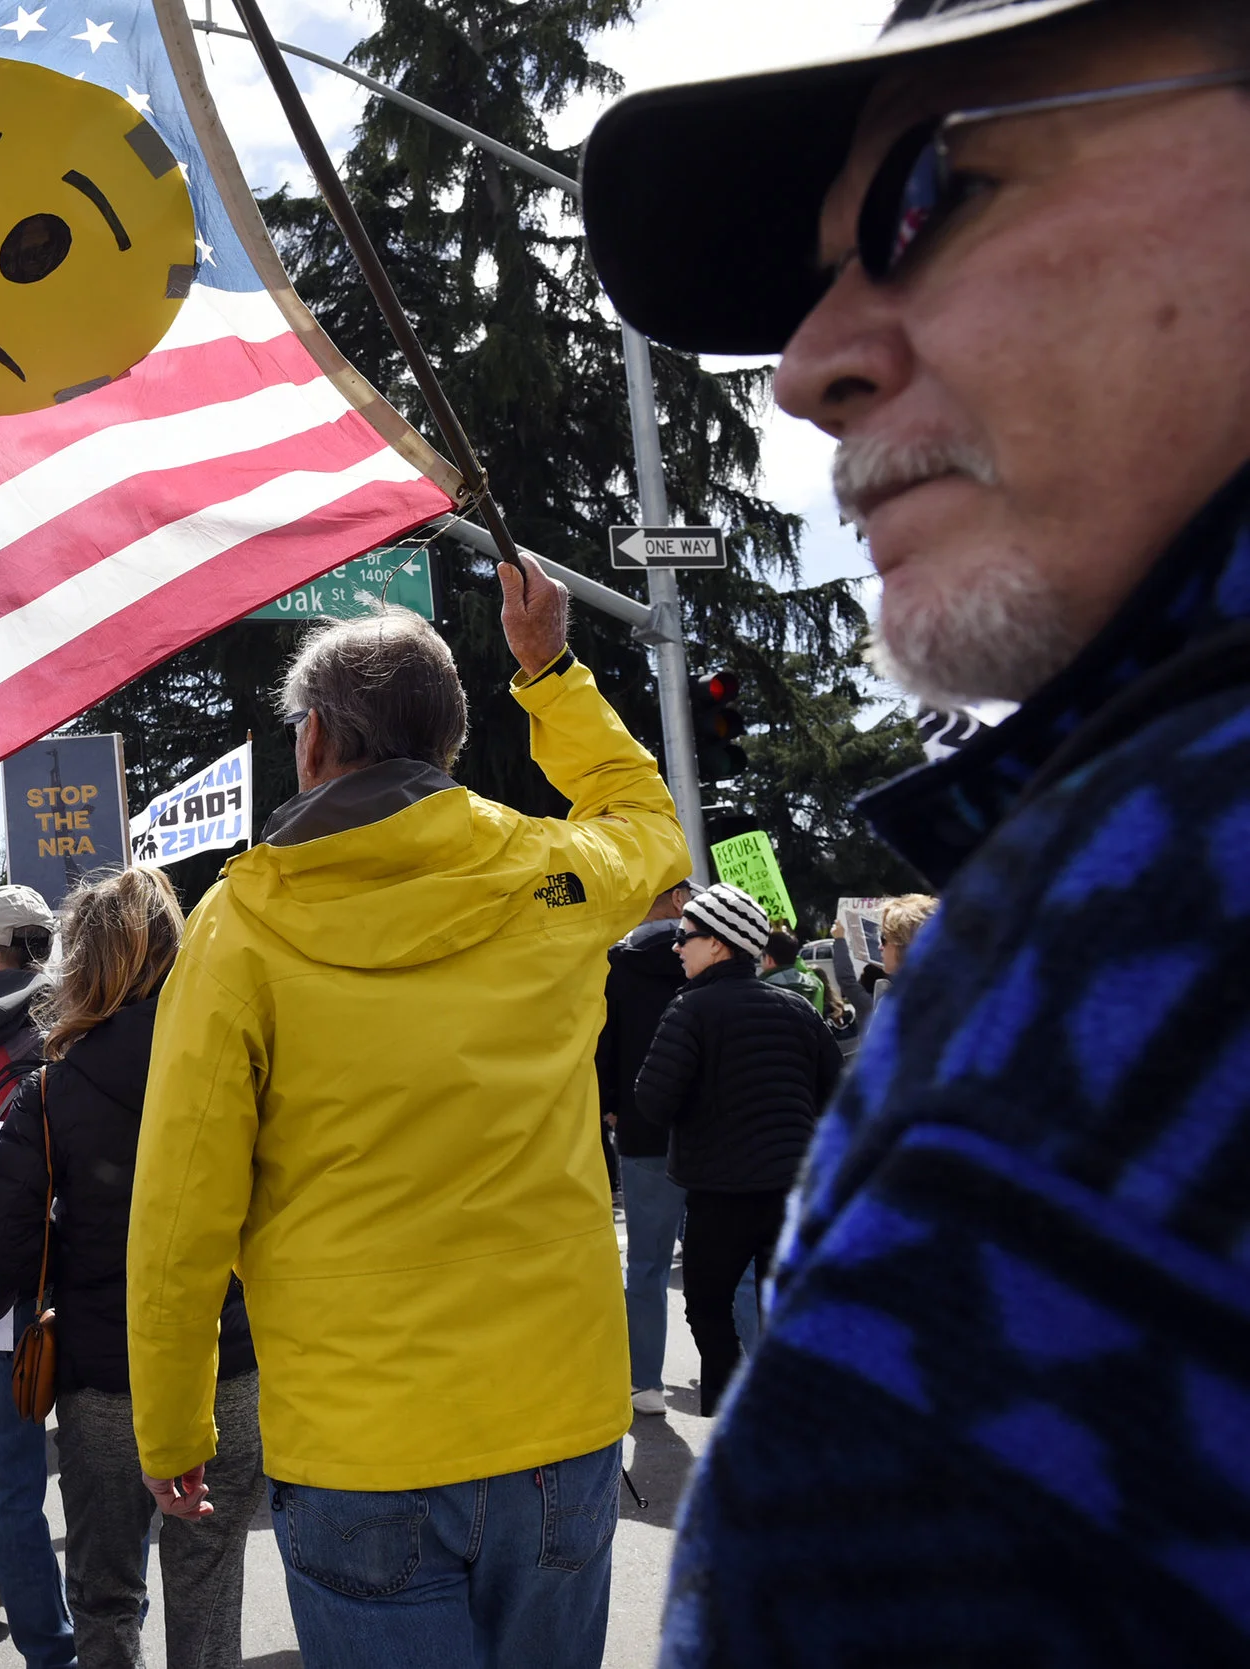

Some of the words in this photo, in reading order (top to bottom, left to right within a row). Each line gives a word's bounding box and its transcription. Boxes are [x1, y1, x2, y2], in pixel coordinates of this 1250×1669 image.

[645, 540, 676, 555] ONE
[680, 540, 711, 555] WAY
[359, 568, 393, 582] 1400
[275, 586, 324, 612] Oak
[332, 588, 346, 601] St
[27, 785, 97, 808] STOP
[35, 810, 91, 832] THE
[37, 835, 97, 857] NRA
[546, 873, 567, 886] THE
[533, 884, 568, 900] NORTH
[546, 895, 571, 908] FACE
